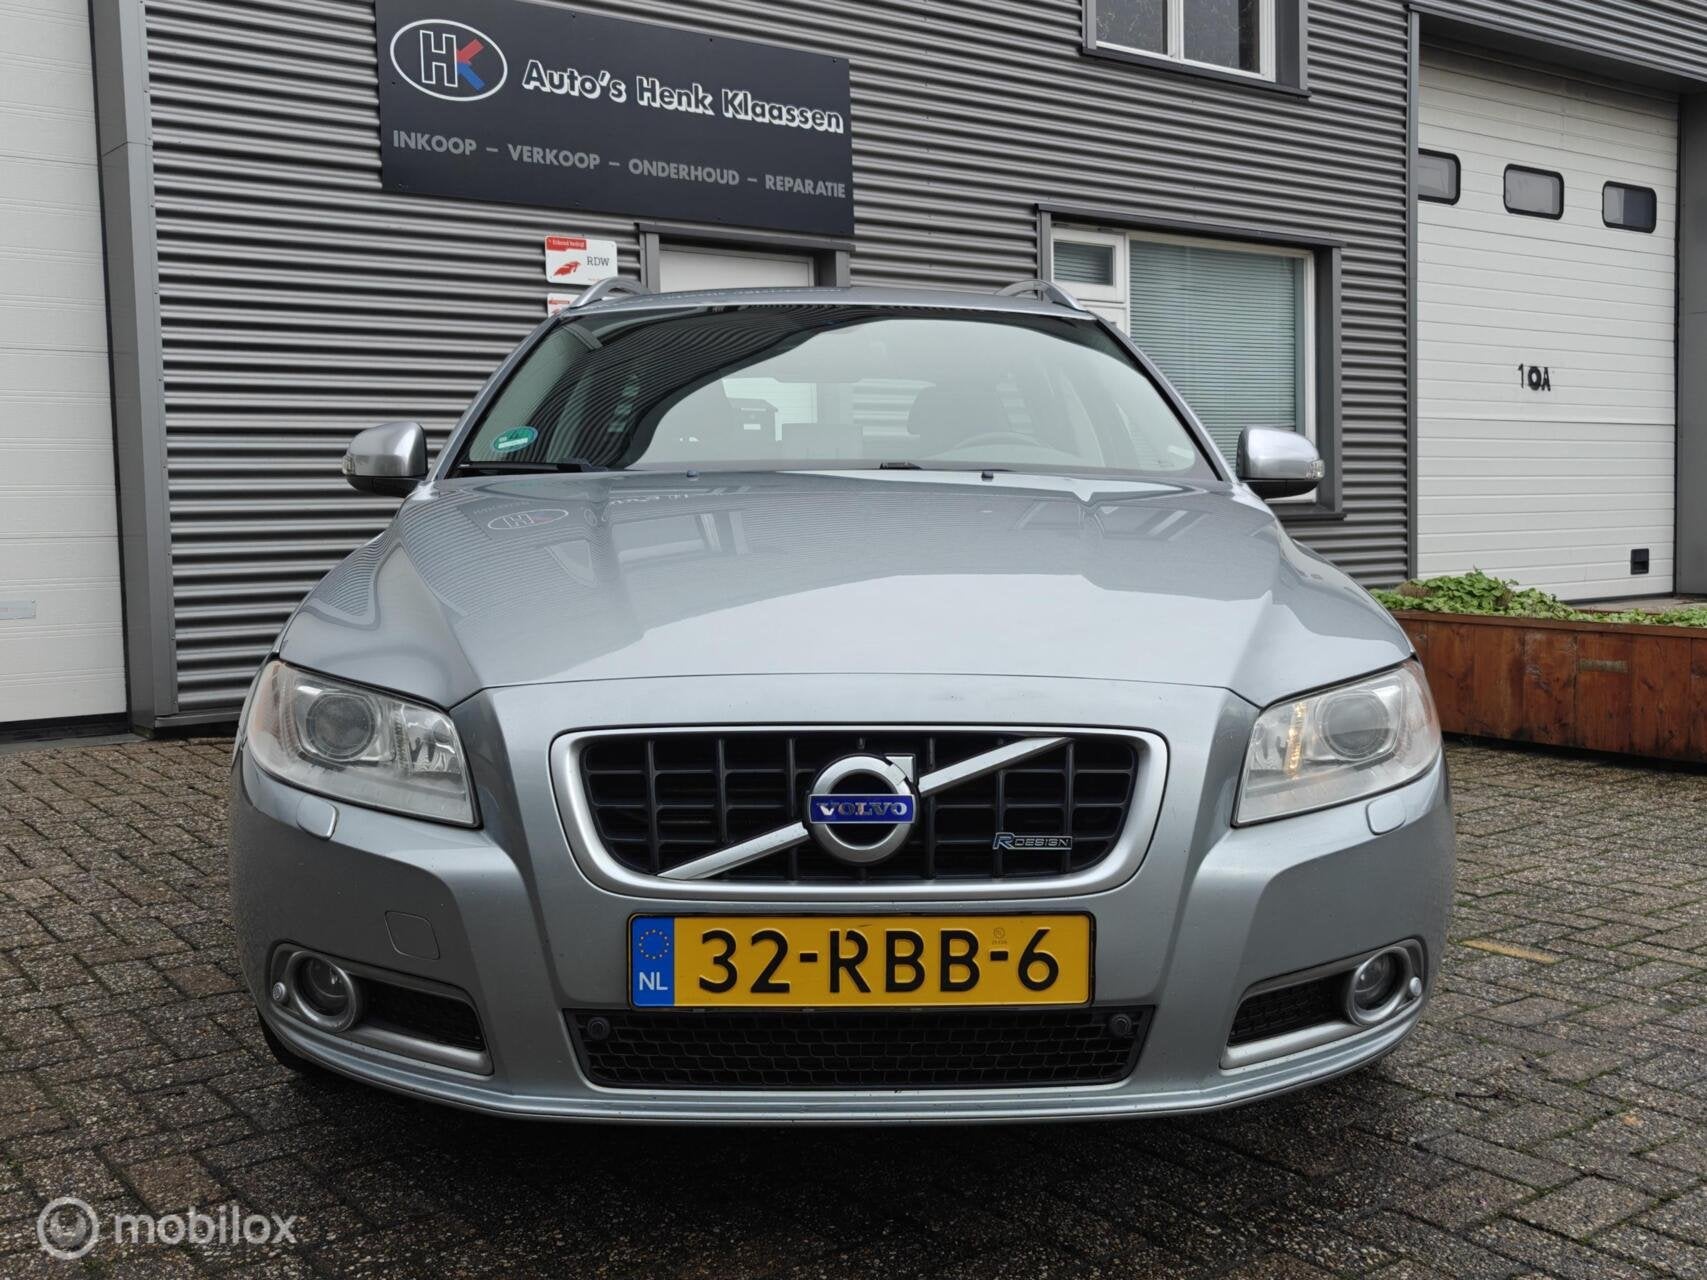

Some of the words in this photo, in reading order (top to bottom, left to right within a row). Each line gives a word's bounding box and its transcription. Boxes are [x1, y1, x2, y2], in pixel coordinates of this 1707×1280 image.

[522, 59, 627, 103] Auto's
[636, 75, 715, 116] Henk
[721, 88, 844, 134] Klaassen
[393, 130, 477, 156] INKOOP
[507, 143, 600, 170] VERKOOP
[628, 158, 740, 185] ONDERHOUD
[765, 174, 847, 199] REPARATIE
[586, 255, 610, 267] RDW
[1518, 363, 1551, 391] 10A
[816, 801, 908, 817] VOLVO
[699, 928, 1060, 994] 32-RBB-6
[638, 972, 668, 992] NL
